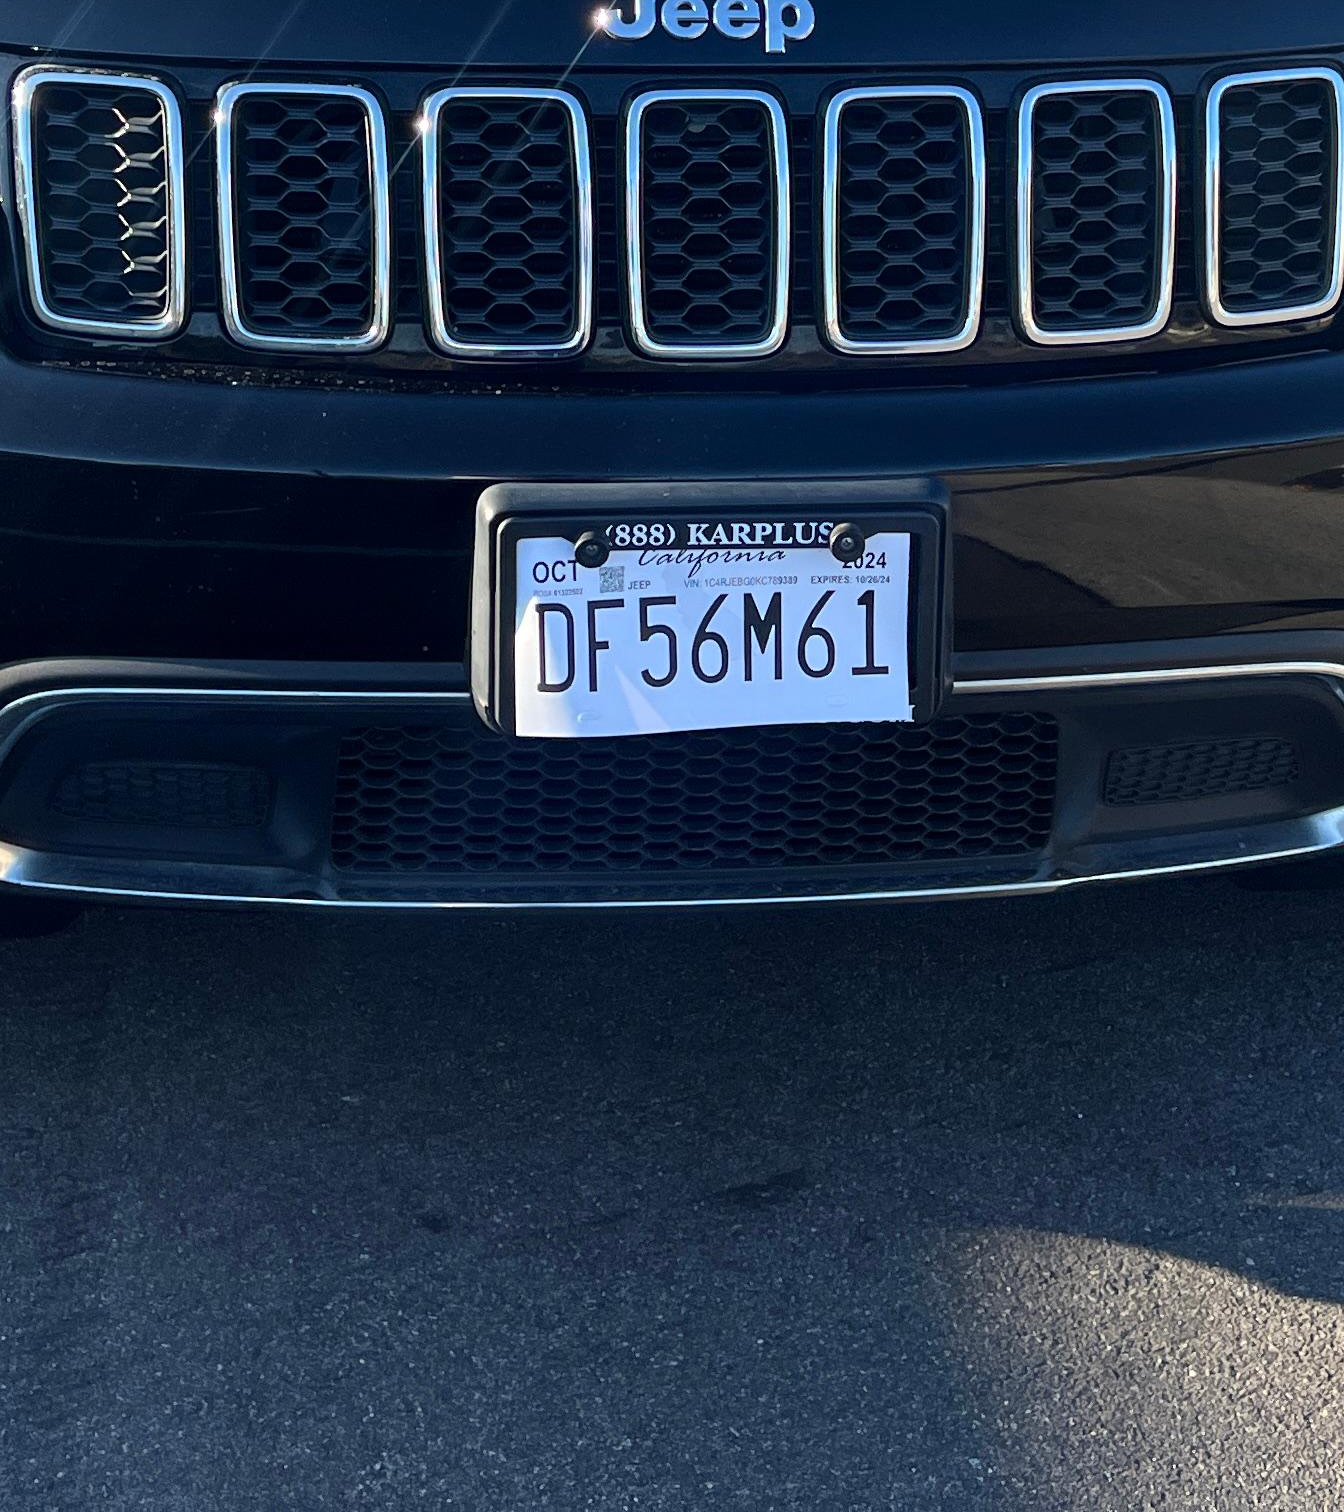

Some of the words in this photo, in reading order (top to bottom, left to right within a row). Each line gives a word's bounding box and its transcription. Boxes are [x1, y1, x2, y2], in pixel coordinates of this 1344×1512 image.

[605, 523, 677, 547] (888)
[687, 522, 834, 546] KARPLUS
[532, 559, 579, 584] OCT
[638, 548, 787, 578] California
[627, 580, 652, 590] JEEP
[536, 589, 890, 694] DF56M61
